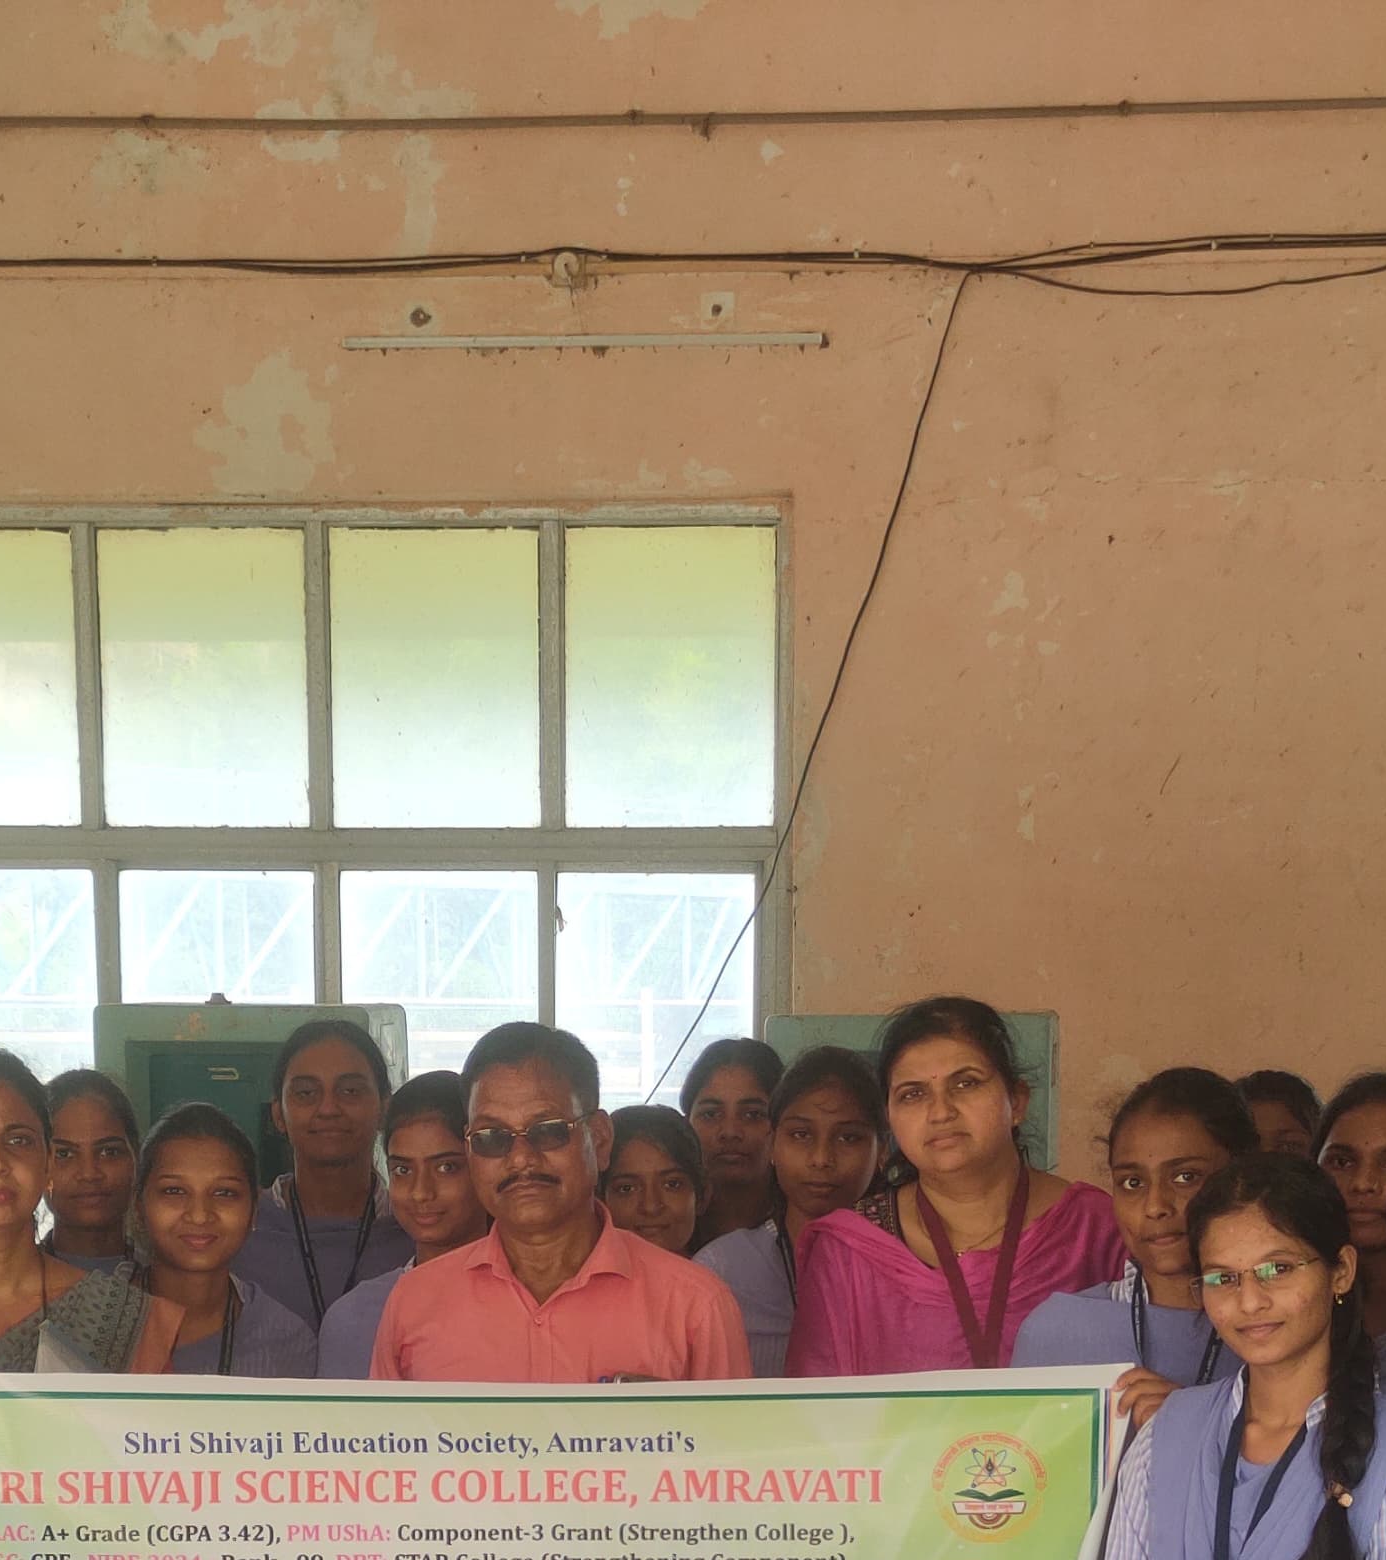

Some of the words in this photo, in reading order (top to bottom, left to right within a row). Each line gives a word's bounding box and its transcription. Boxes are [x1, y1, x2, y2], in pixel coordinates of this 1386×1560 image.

[124, 1431, 182, 1455] Shri
[189, 1431, 283, 1460] Shivaji
[293, 1431, 428, 1454] Education
[438, 1431, 539, 1460] Society,
[546, 1430, 695, 1453] Amravati's
[57, 1470, 222, 1513] SHIVAJI
[235, 1469, 418, 1504] SCIENCE
[430, 1469, 638, 1509] COLLEGE,
[649, 1469, 882, 1503] AMRAVATI
[41, 1524, 70, 1542] A+
[75, 1524, 141, 1543] Grade
[147, 1524, 212, 1547] (CGPA
[218, 1524, 281, 1547] 3.42),
[287, 1524, 320, 1542] PM
[326, 1523, 391, 1542] UShA:
[397, 1524, 544, 1546] Component-3
[551, 1523, 613, 1541] Grant
[619, 1523, 748, 1546] (Strengthen
[754, 1523, 834, 1546] College
[839, 1523, 855, 1546] ),
